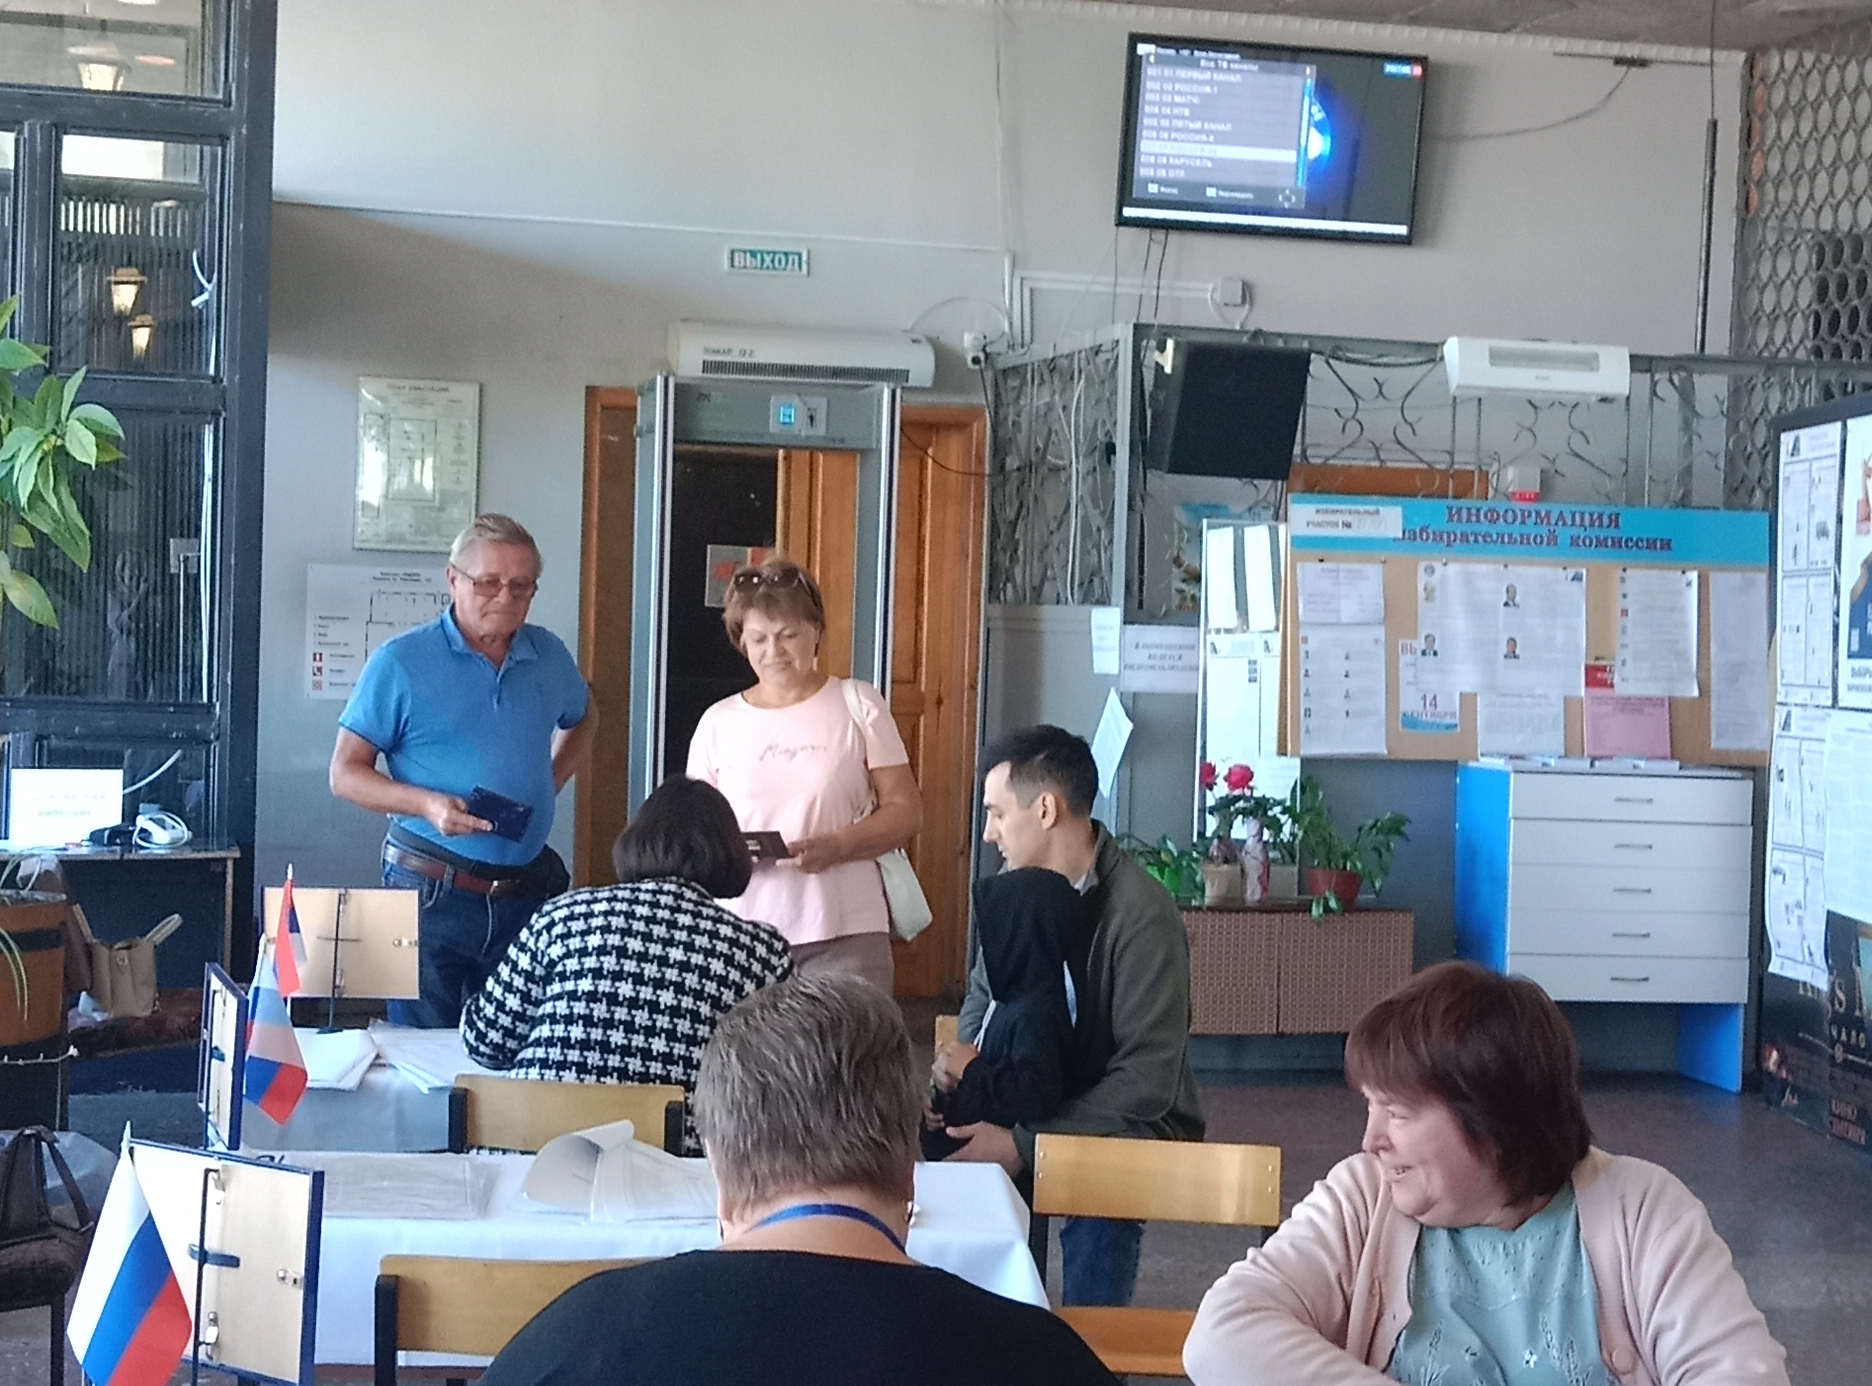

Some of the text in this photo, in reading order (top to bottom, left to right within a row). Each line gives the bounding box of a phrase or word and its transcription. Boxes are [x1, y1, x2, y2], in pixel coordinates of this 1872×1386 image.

[734, 251, 800, 271] ВЫХОД
[1446, 505, 1621, 532] ИНФОРМАЦИЯ
[1569, 534, 1672, 551] комиссии
[1421, 694, 1438, 710] 14
